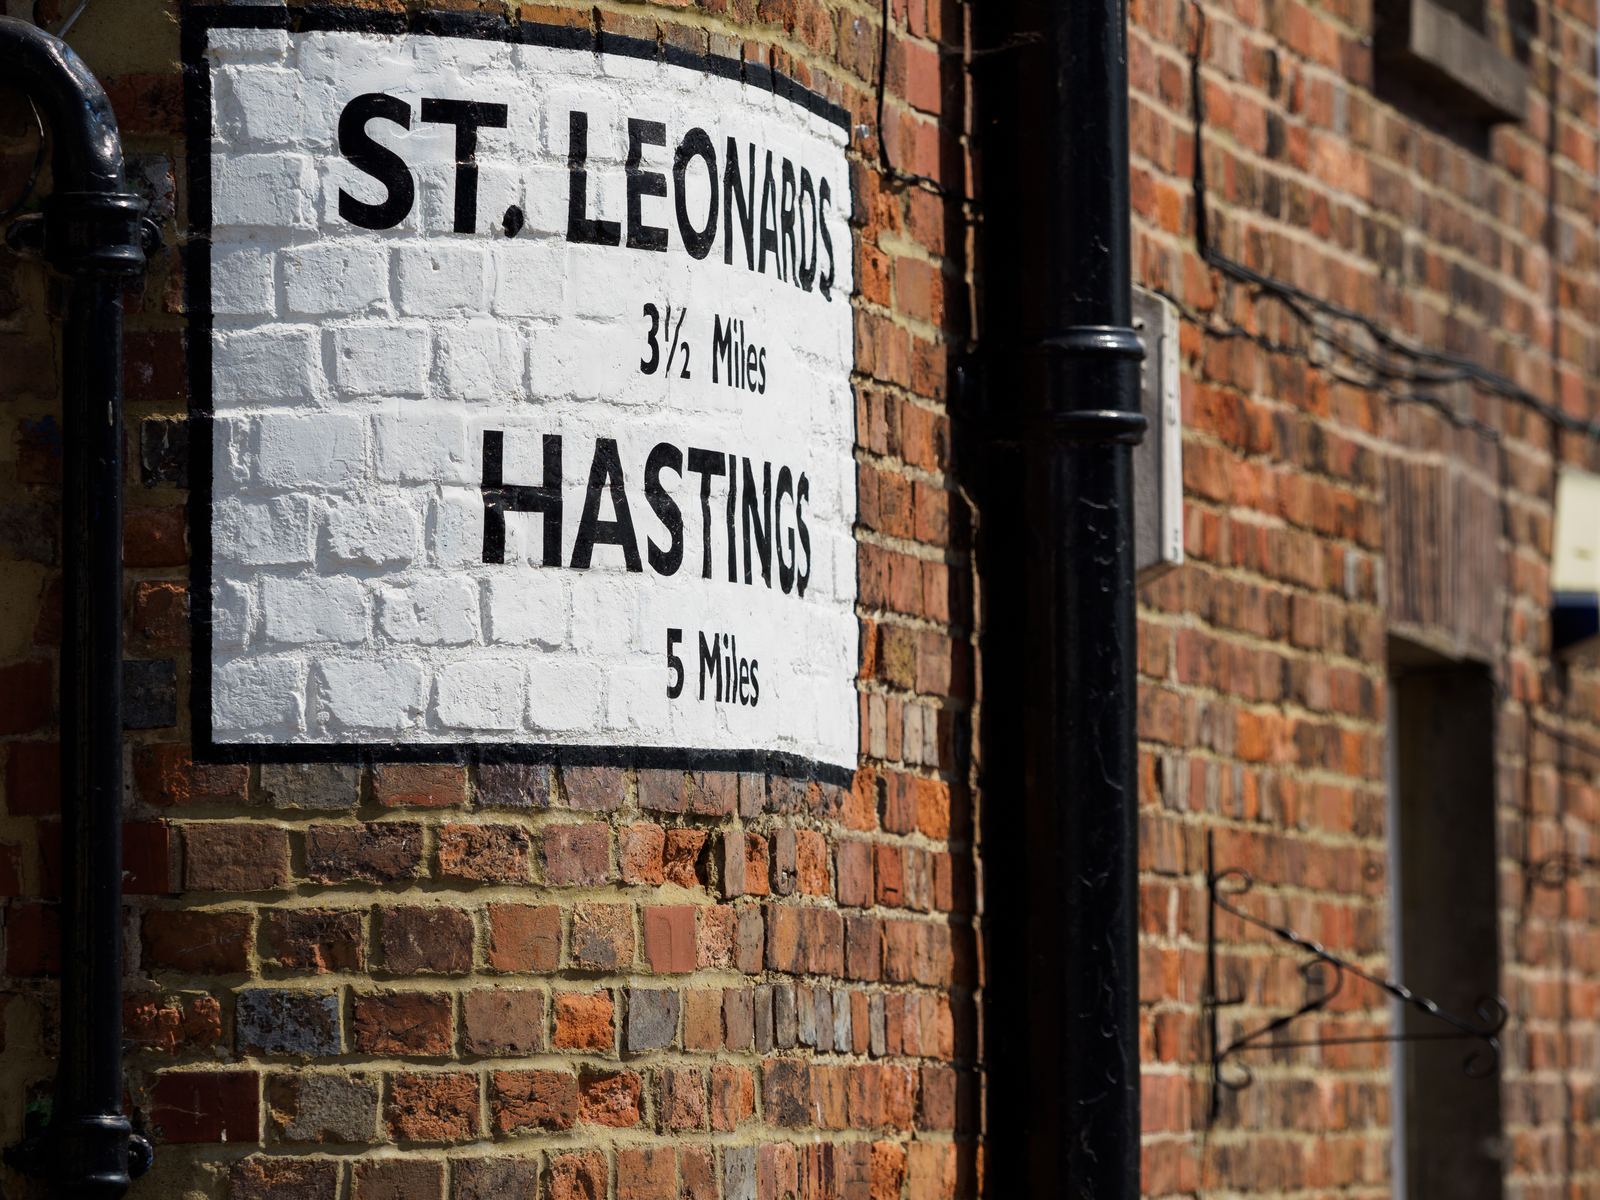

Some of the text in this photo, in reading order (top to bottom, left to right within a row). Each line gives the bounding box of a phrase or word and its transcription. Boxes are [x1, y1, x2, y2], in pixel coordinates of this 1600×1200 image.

[338, 92, 836, 303] ST. LEONARDS
[712, 313, 767, 395] Miles
[480, 430, 811, 598] HASTINGS
[667, 628, 760, 707] 5 Miles
